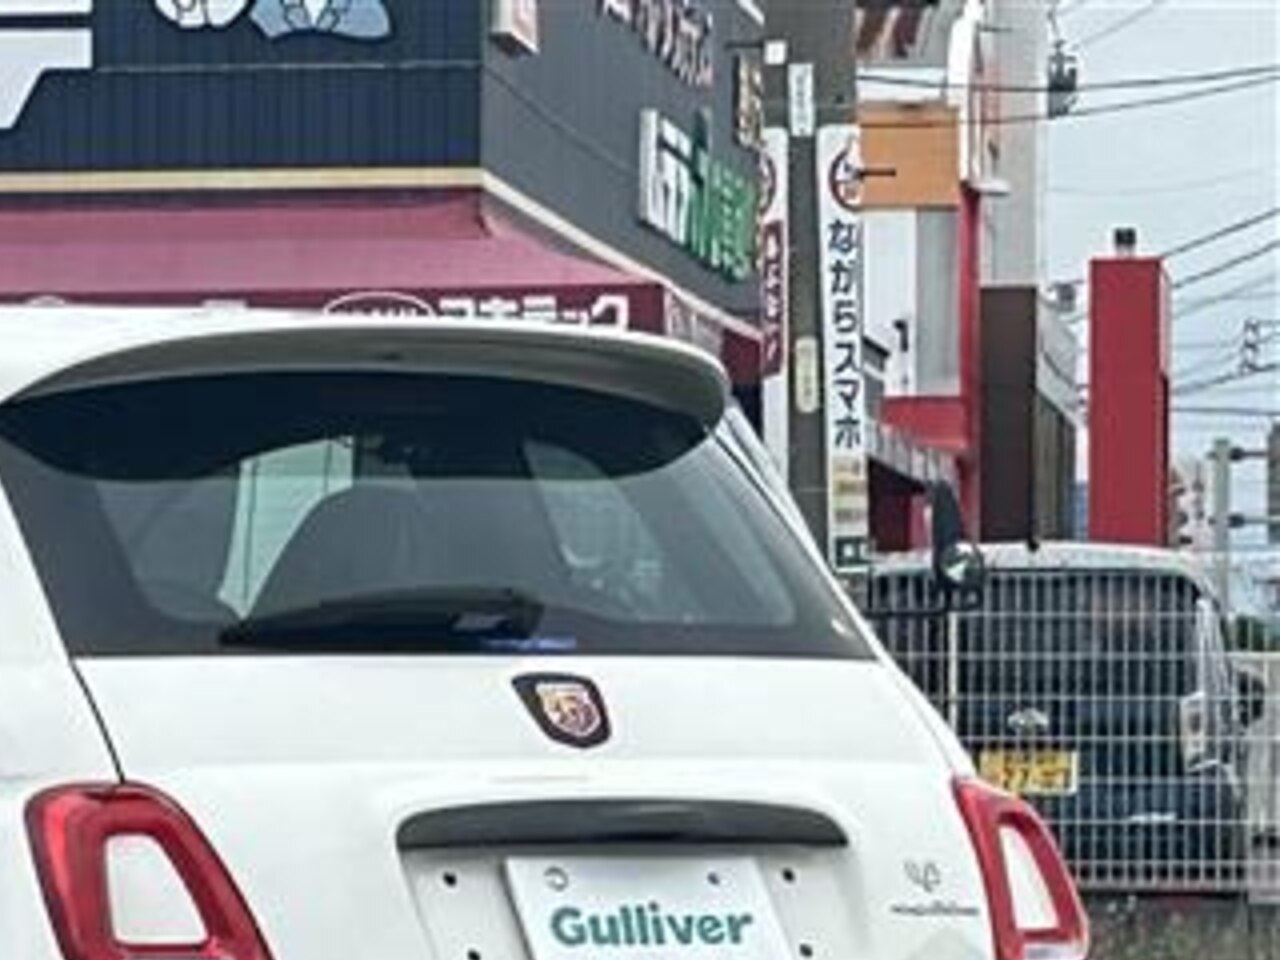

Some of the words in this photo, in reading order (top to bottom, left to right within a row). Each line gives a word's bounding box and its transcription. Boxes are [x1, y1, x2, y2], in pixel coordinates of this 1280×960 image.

[827, 218, 862, 449] ながらスマホ
[550, 901, 753, 947] Gulliver
